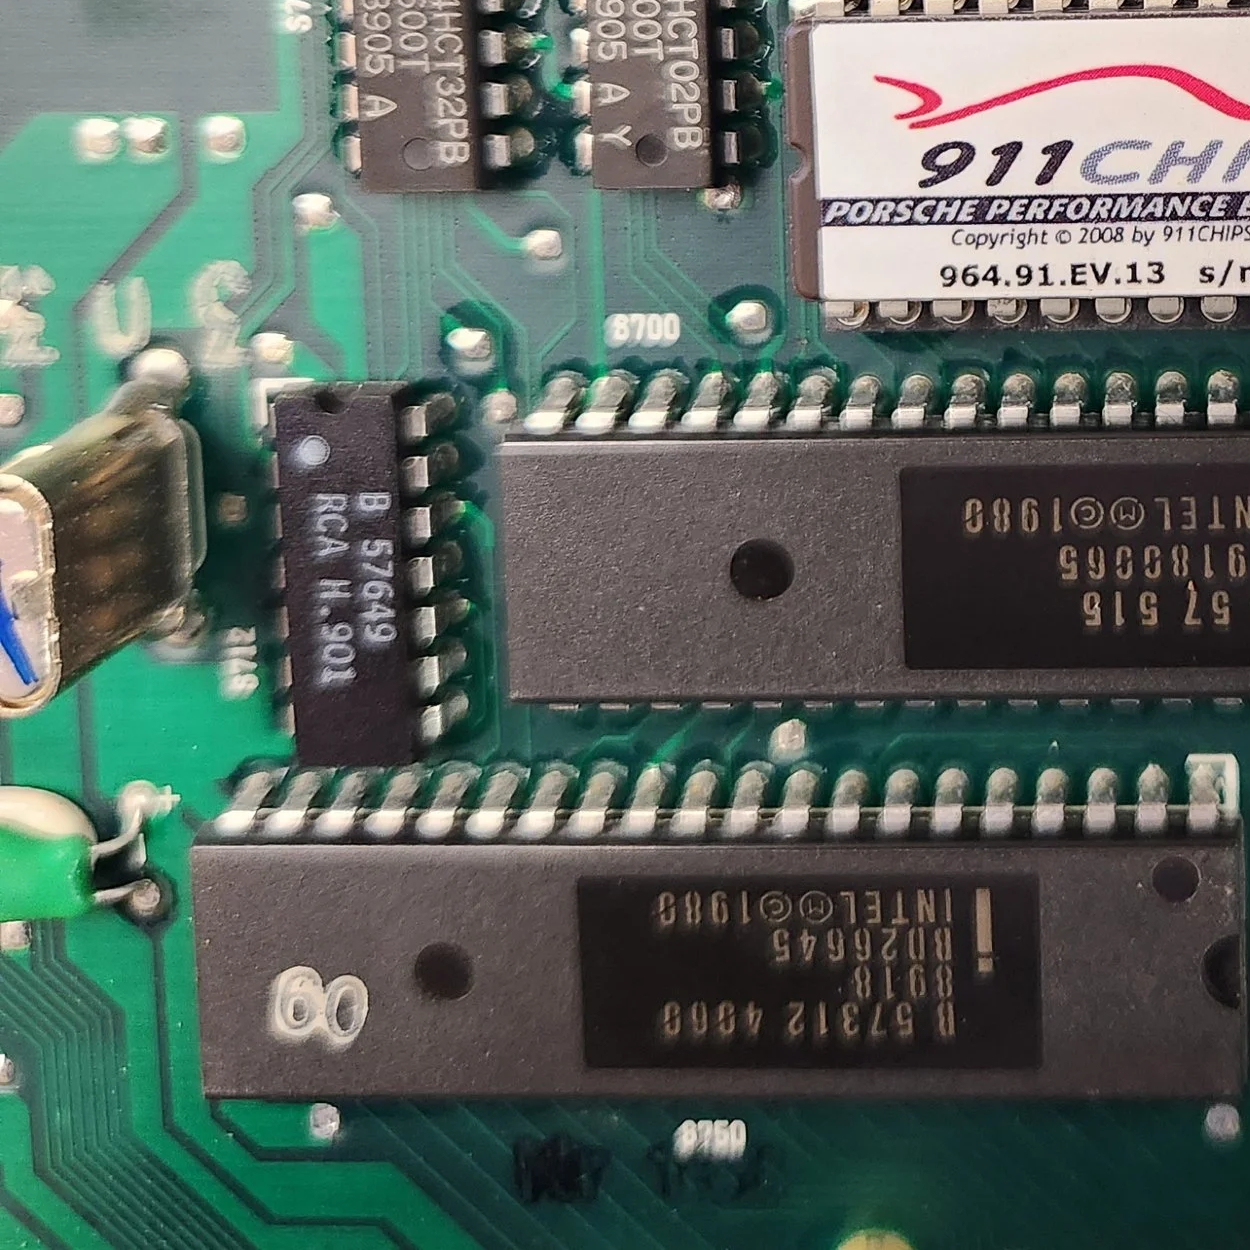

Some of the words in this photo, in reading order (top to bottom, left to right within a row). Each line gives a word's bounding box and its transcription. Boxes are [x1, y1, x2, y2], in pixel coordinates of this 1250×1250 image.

[363, 93, 397, 118] A
[596, 83, 631, 105] A
[602, 125, 632, 147] Y
[823, 199, 976, 225] PORSCHE
[984, 194, 1232, 223] PERFORMANCE
[951, 227, 1048, 249] Copyright
[1077, 226, 1124, 244] 2008
[1131, 225, 1155, 246] by
[939, 260, 1166, 288] 964.91.EV.13
[357, 491, 393, 513] B
[315, 492, 351, 558] RCA
[361, 538, 398, 645] 57649
[1083, 589, 1158, 626] 515
[1183, 588, 1230, 626] 57
[318, 578, 357, 685] H.901
[787, 1001, 915, 1038] 57312
[937, 1002, 957, 1038] B
